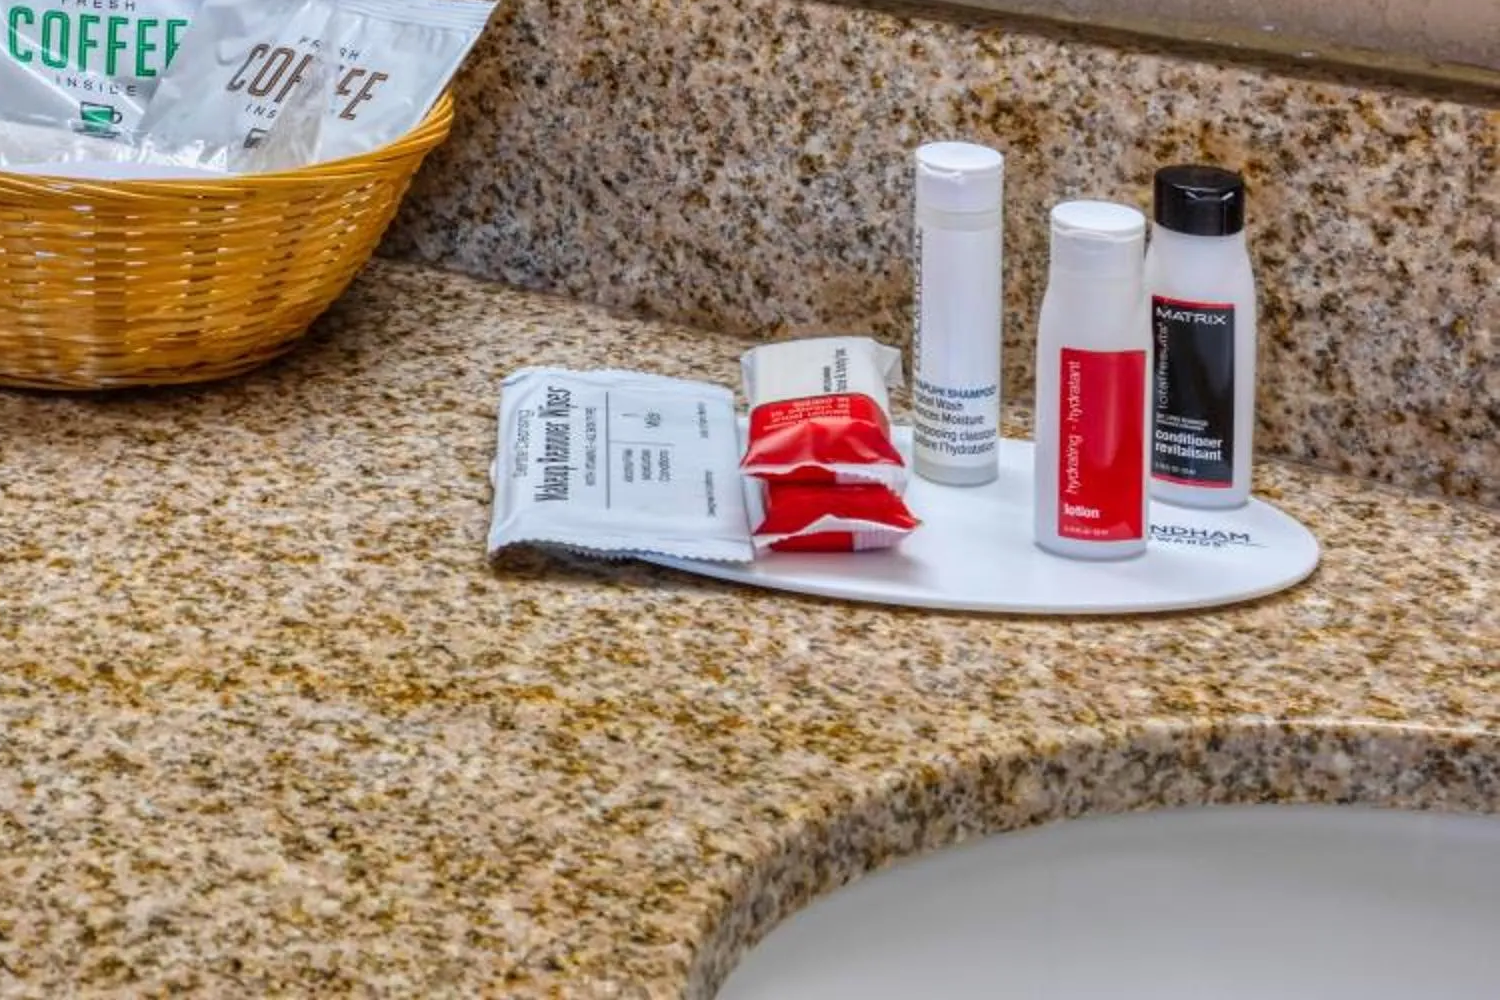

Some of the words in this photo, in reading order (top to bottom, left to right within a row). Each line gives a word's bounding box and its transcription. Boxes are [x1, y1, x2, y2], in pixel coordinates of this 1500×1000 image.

[55, 74, 138, 97] INSIDE
[225, 42, 390, 121] COFEE
[1155, 305, 1228, 326] MATRIX
[538, 385, 579, 419] Wipes
[1066, 361, 1084, 423] hydratant
[536, 421, 572, 464] Remover
[1156, 429, 1223, 449] conditioner
[1156, 442, 1222, 461] revitalisant
[1065, 433, 1084, 495] hydrating
[533, 464, 578, 502] Makeup
[1063, 502, 1100, 519] lotion
[1149, 524, 1251, 543] NDHAM
[1149, 536, 1223, 548] WARDS
